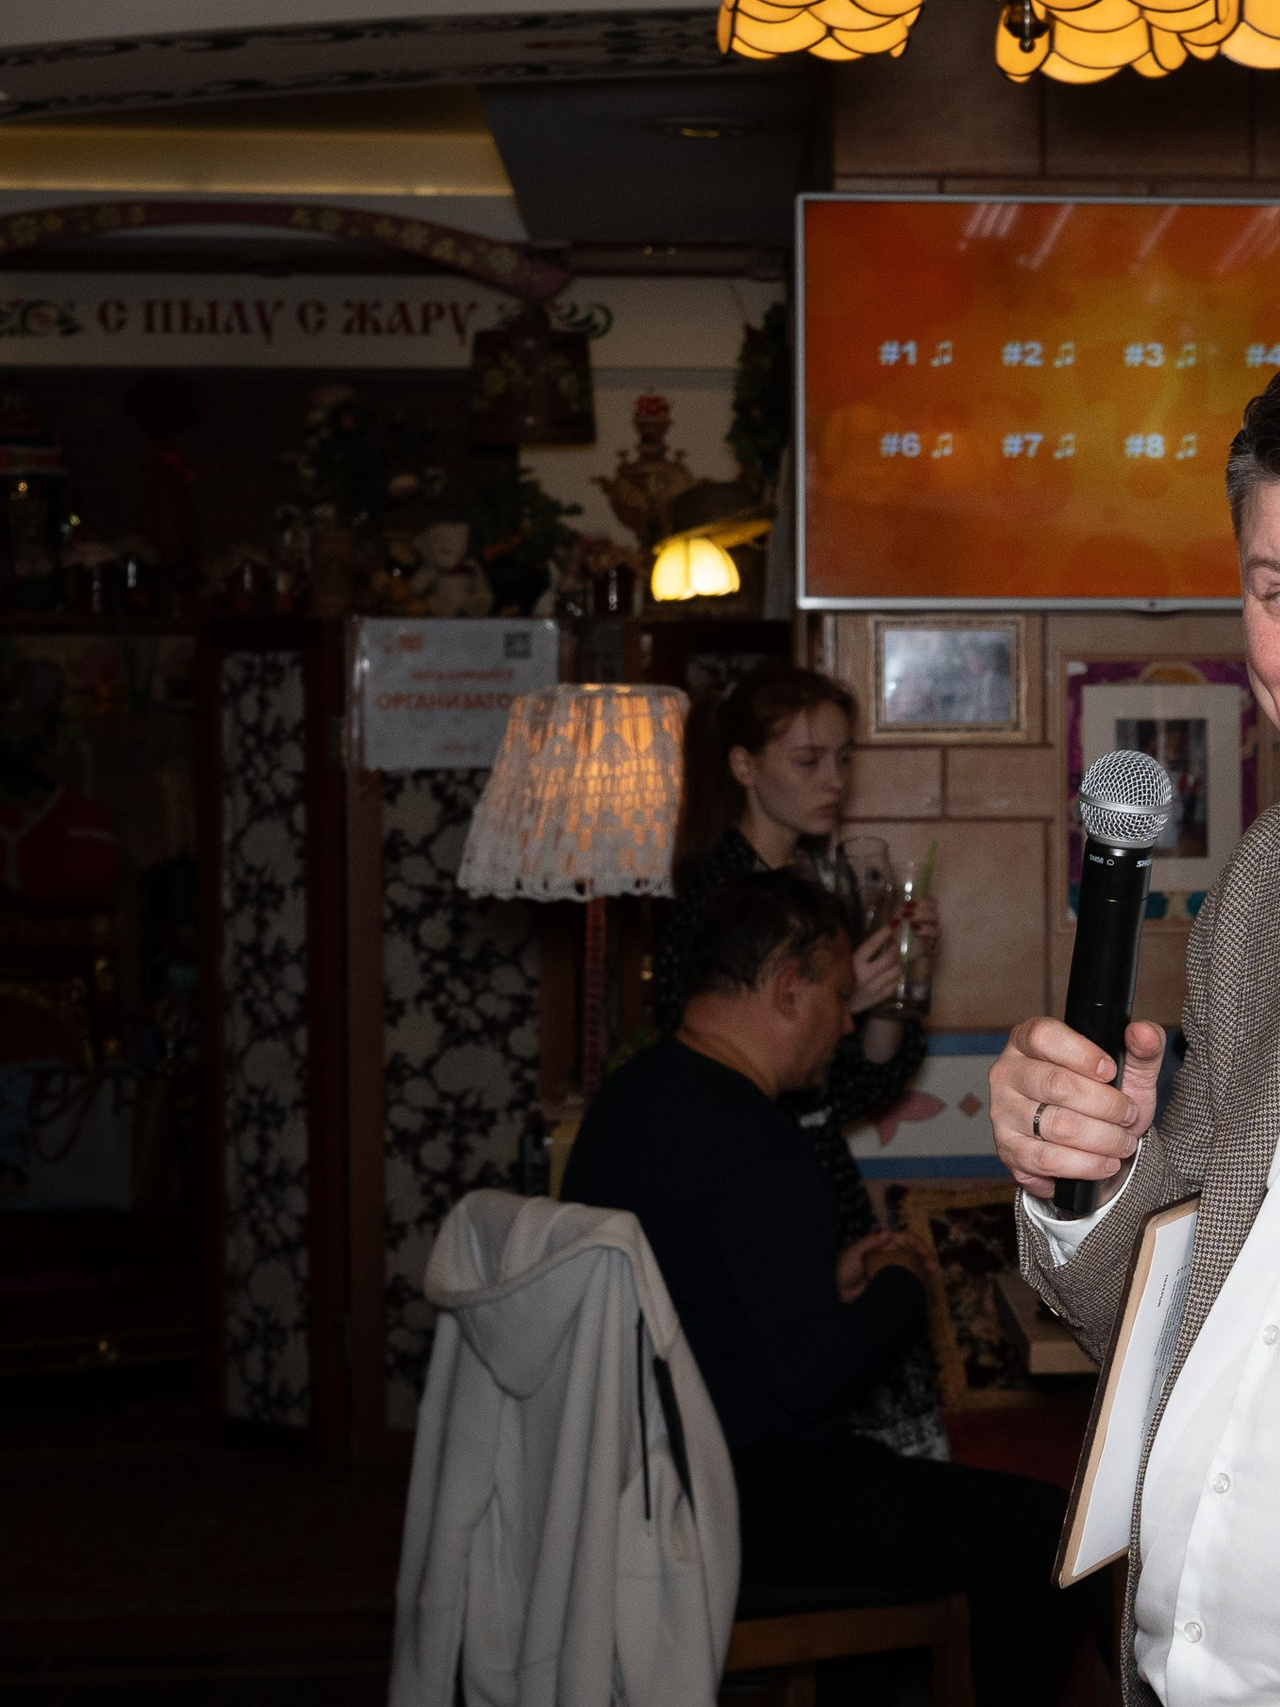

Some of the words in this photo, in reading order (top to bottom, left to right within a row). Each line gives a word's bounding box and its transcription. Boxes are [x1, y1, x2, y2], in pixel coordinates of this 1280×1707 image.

[99, 300, 127, 334] С
[142, 300, 286, 345] ПЫЛУ
[296, 300, 327, 334] С
[342, 301, 479, 347] ЖАРУ
[878, 340, 918, 367] #1
[1001, 341, 1044, 368] #2
[1123, 341, 1165, 368] #3
[879, 431, 921, 459] #6
[1002, 432, 1044, 459] #7
[1123, 432, 1166, 459] #8
[376, 691, 514, 711] ОРГАНИЗАТО
